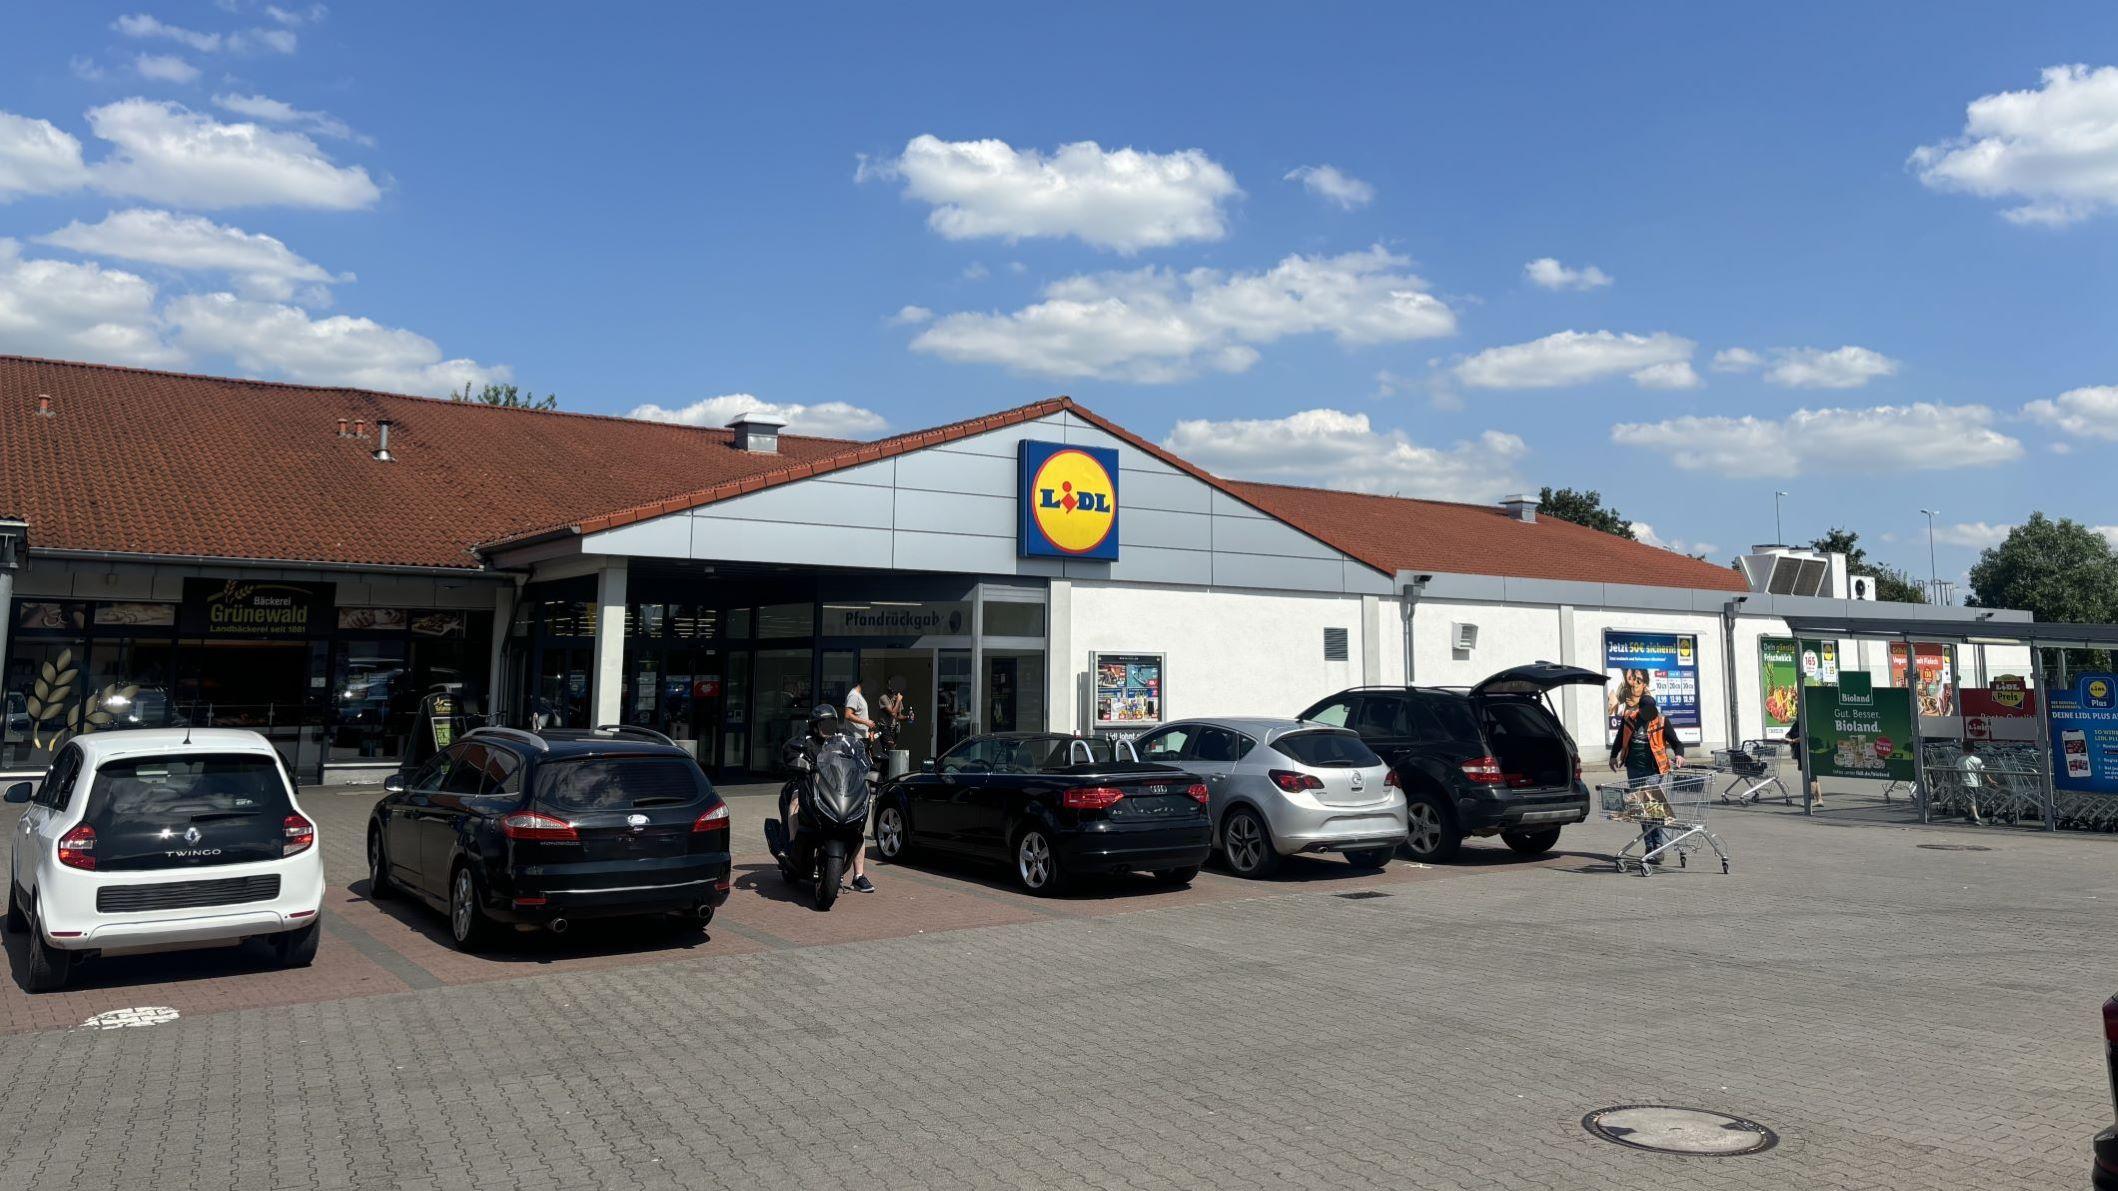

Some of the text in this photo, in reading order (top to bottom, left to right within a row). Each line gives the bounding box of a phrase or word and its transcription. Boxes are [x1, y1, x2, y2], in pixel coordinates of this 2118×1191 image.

[254, 596, 291, 606] Bäckerei
[210, 603, 308, 624] Grünewald
[845, 611, 942, 630] Pfandrückgab
[208, 625, 268, 633] Landbäckerei
[1608, 641, 1629, 653] Jetzt
[1646, 642, 1677, 654] sichern!
[1763, 643, 1776, 651] Dein
[1763, 653, 1792, 662] Frischekick
[1841, 693, 1870, 702] Bioland
[1997, 692, 2018, 701] Preis
[2091, 699, 2107, 707] Plus
[1834, 708, 1881, 719] Gut. Besser.
[2052, 711, 2074, 719] DEINE
[1834, 720, 1882, 732] Bioland.
[1106, 732, 1118, 741] Lidl
[165, 848, 223, 858] TWINGO
